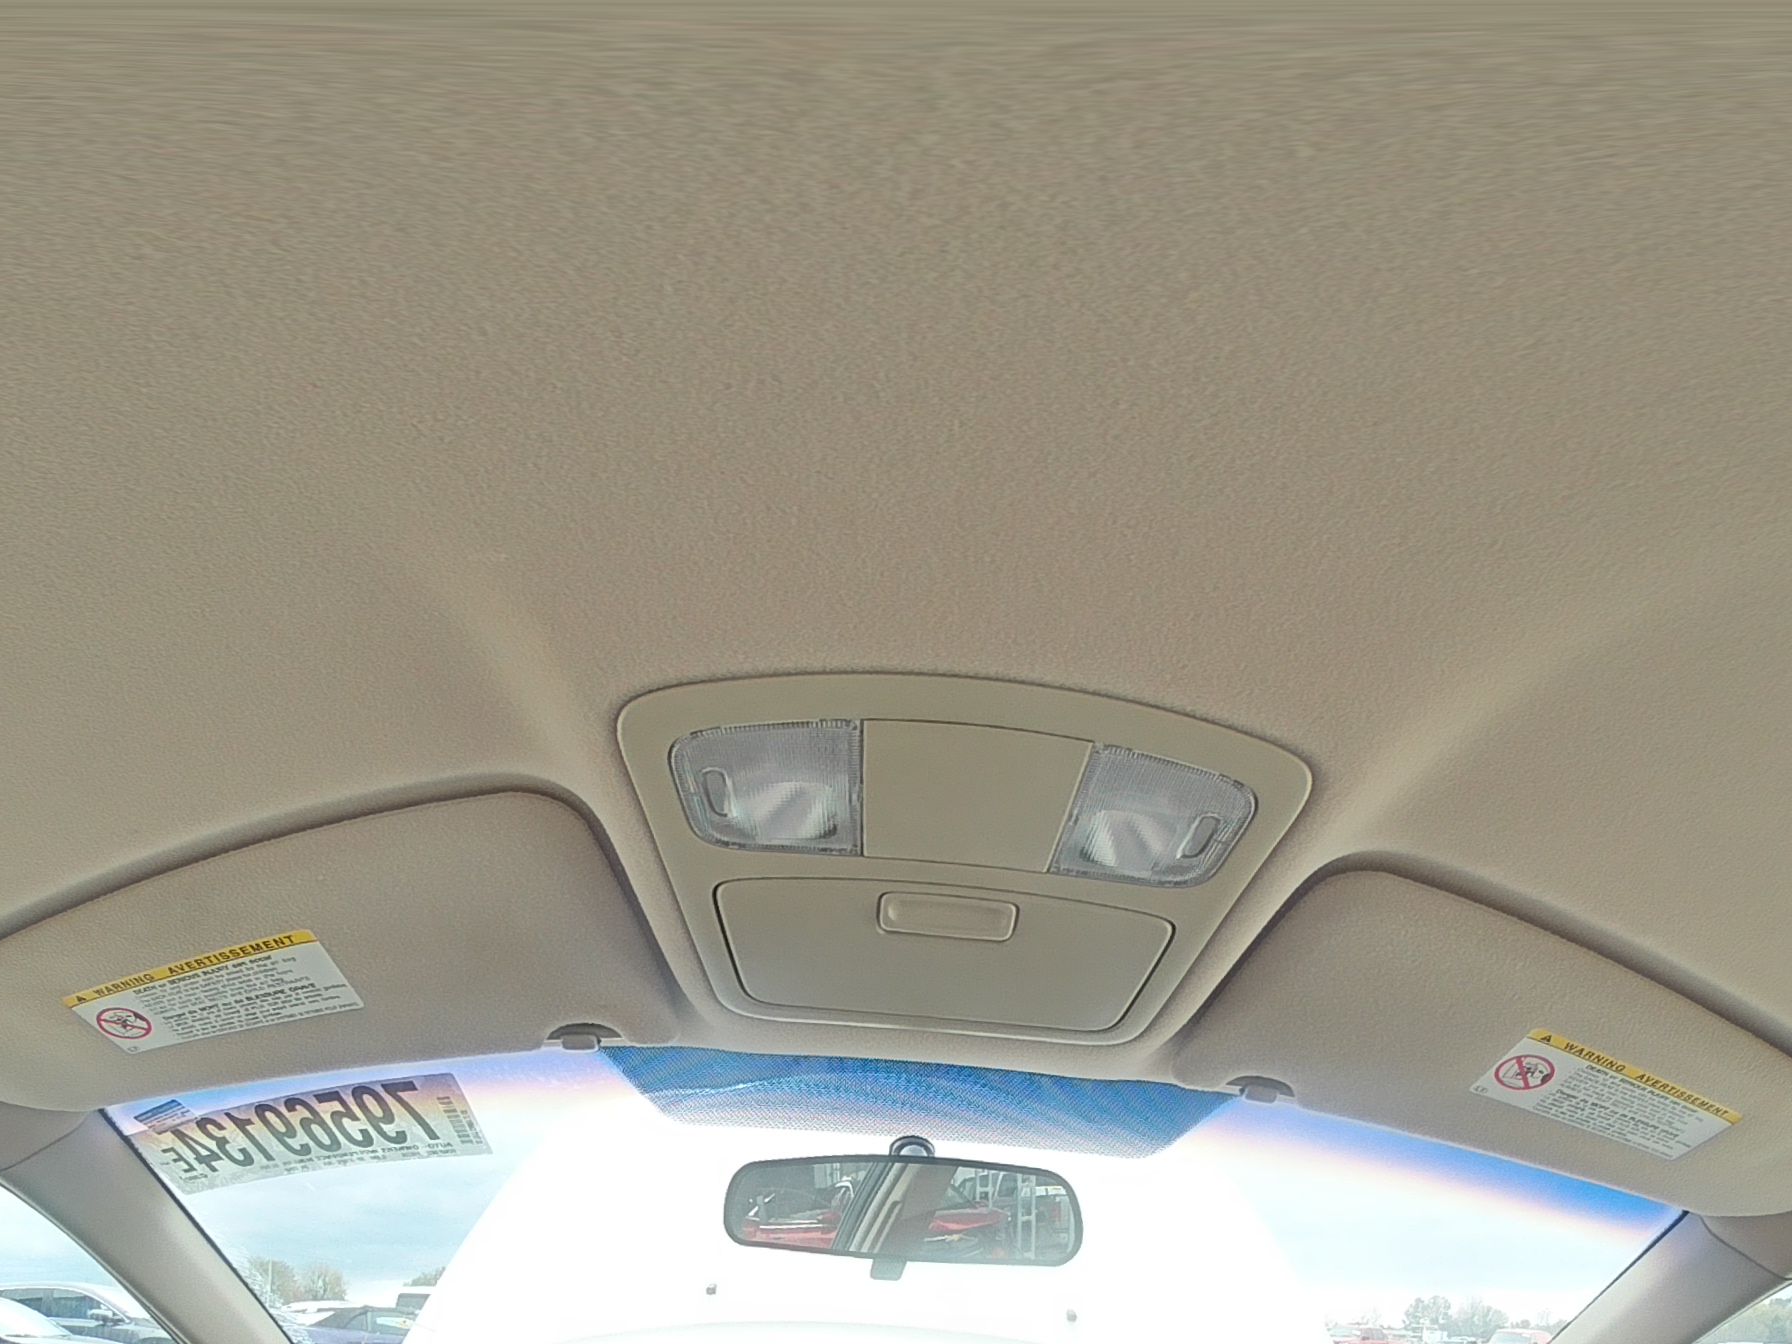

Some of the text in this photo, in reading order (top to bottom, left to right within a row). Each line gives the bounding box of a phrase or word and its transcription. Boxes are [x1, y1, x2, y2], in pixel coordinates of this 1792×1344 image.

[93, 970, 156, 998] WARNING
[167, 934, 296, 975] AVERTISSEMENT
[1563, 1041, 1626, 1074] WARNING
[1635, 1073, 1730, 1117] AVERTISSEMENT
